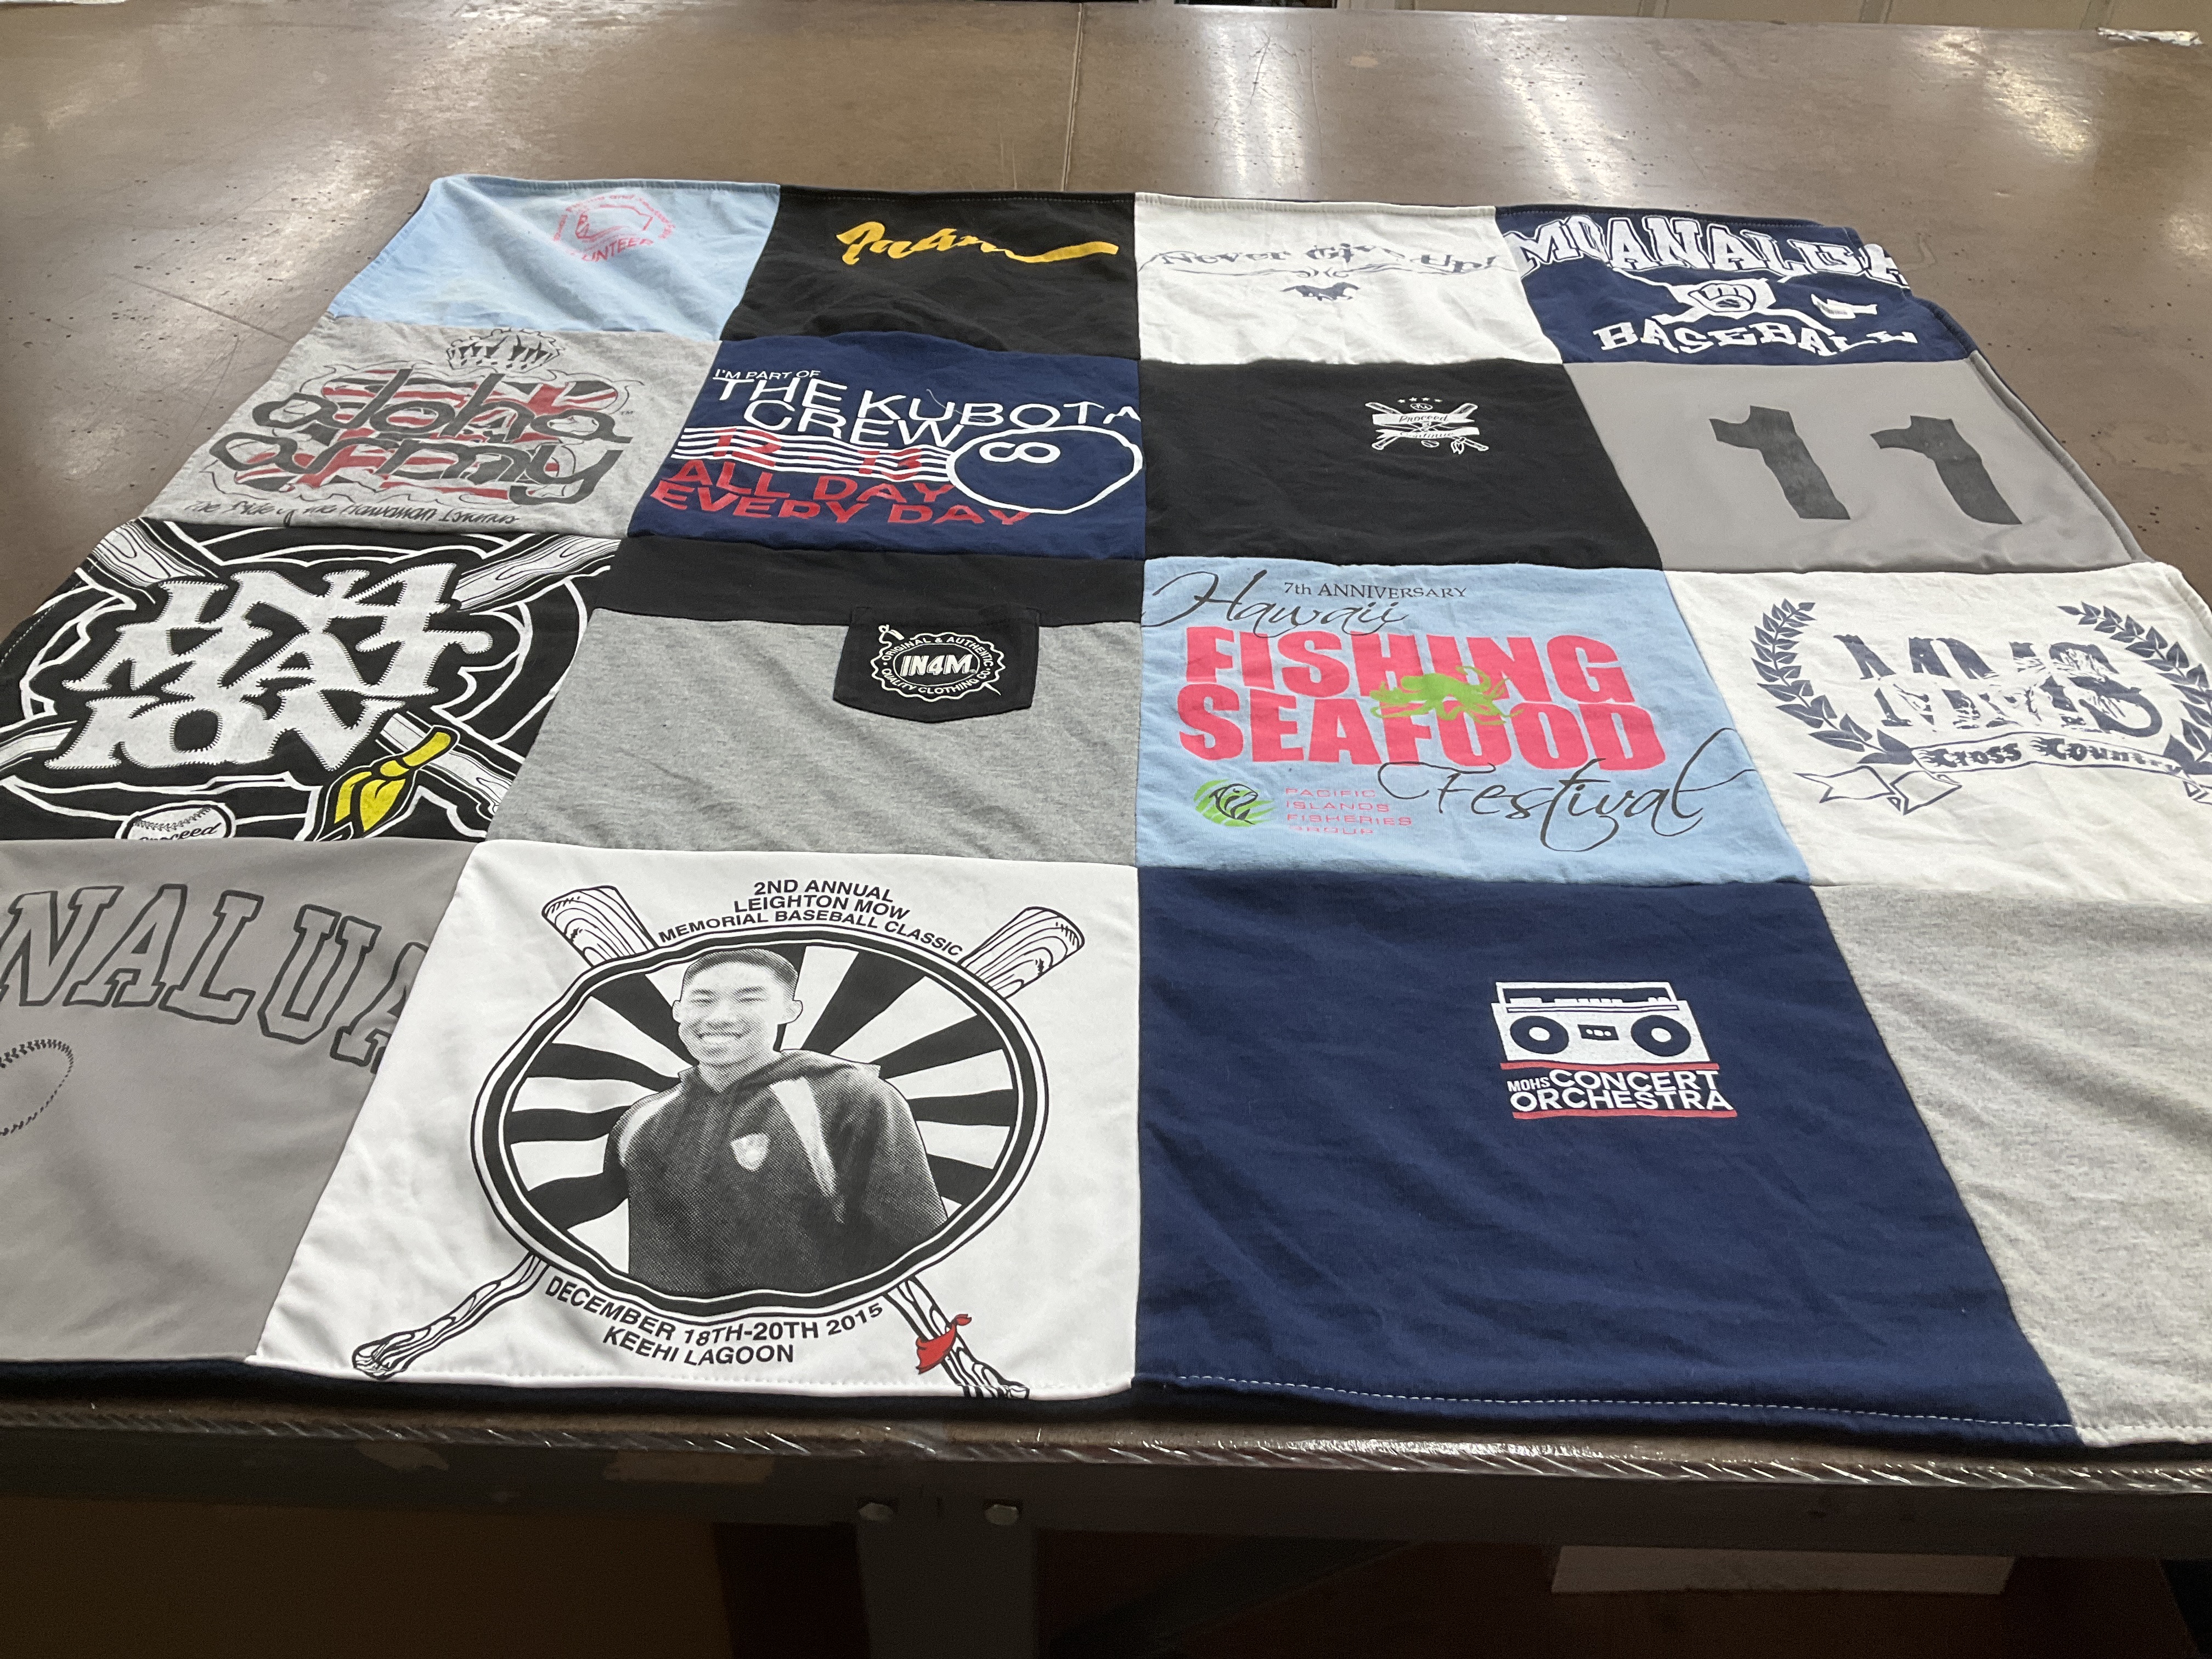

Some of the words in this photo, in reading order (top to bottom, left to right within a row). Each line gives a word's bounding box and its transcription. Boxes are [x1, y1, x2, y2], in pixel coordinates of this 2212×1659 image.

[1593, 318, 1918, 356] BASEBALL
[714, 368, 741, 381] I'M
[744, 370, 793, 380] PART
[795, 370, 822, 379] OF
[713, 377, 847, 413] THE
[858, 389, 1141, 428] KUBOTA
[743, 399, 964, 447] CREW
[670, 460, 790, 499] ALL
[814, 476, 957, 504] DAY
[650, 480, 871, 523] EVERY
[887, 503, 1031, 526] DAY
[1141, 569, 1410, 639] Hawaii
[1284, 582, 1312, 596] 7th
[1317, 583, 1469, 599] ANNIVERSARY
[881, 637, 932, 661] ORIGINAL
[948, 636, 994, 667] AUTHENTIC
[1186, 625, 1636, 704] FISHING
[881, 669, 915, 691] QUALITY
[918, 678, 983, 695] CLOTHING
[1178, 682, 1669, 771] SEAFOOD
[1920, 743, 2022, 768] Cross
[1285, 788, 1375, 798] PACIFIC
[1286, 800, 1390, 812] ISLANDS
[1287, 814, 1413, 826] FISHERIES
[753, 879, 799, 896] 2ND
[804, 879, 895, 903] ANNUAL
[734, 894, 849, 913] LEIGHTON
[854, 898, 911, 921] MOW
[658, 912, 769, 943] MEMORIAL
[775, 910, 878, 929] BASEBALL
[884, 920, 964, 957] CLASSIC
[1506, 1076, 1551, 1092] MOHS
[1549, 1069, 1719, 1092] CONCERT
[1510, 1088, 1734, 1113] ORCHESTRA
[545, 1276, 677, 1341] DECEMBER
[684, 1321, 819, 1347] 18TH-20TH
[827, 1302, 884, 1336] 2015
[602, 1325, 679, 1363] KEEHI
[684, 1344, 794, 1367] LAGOON
